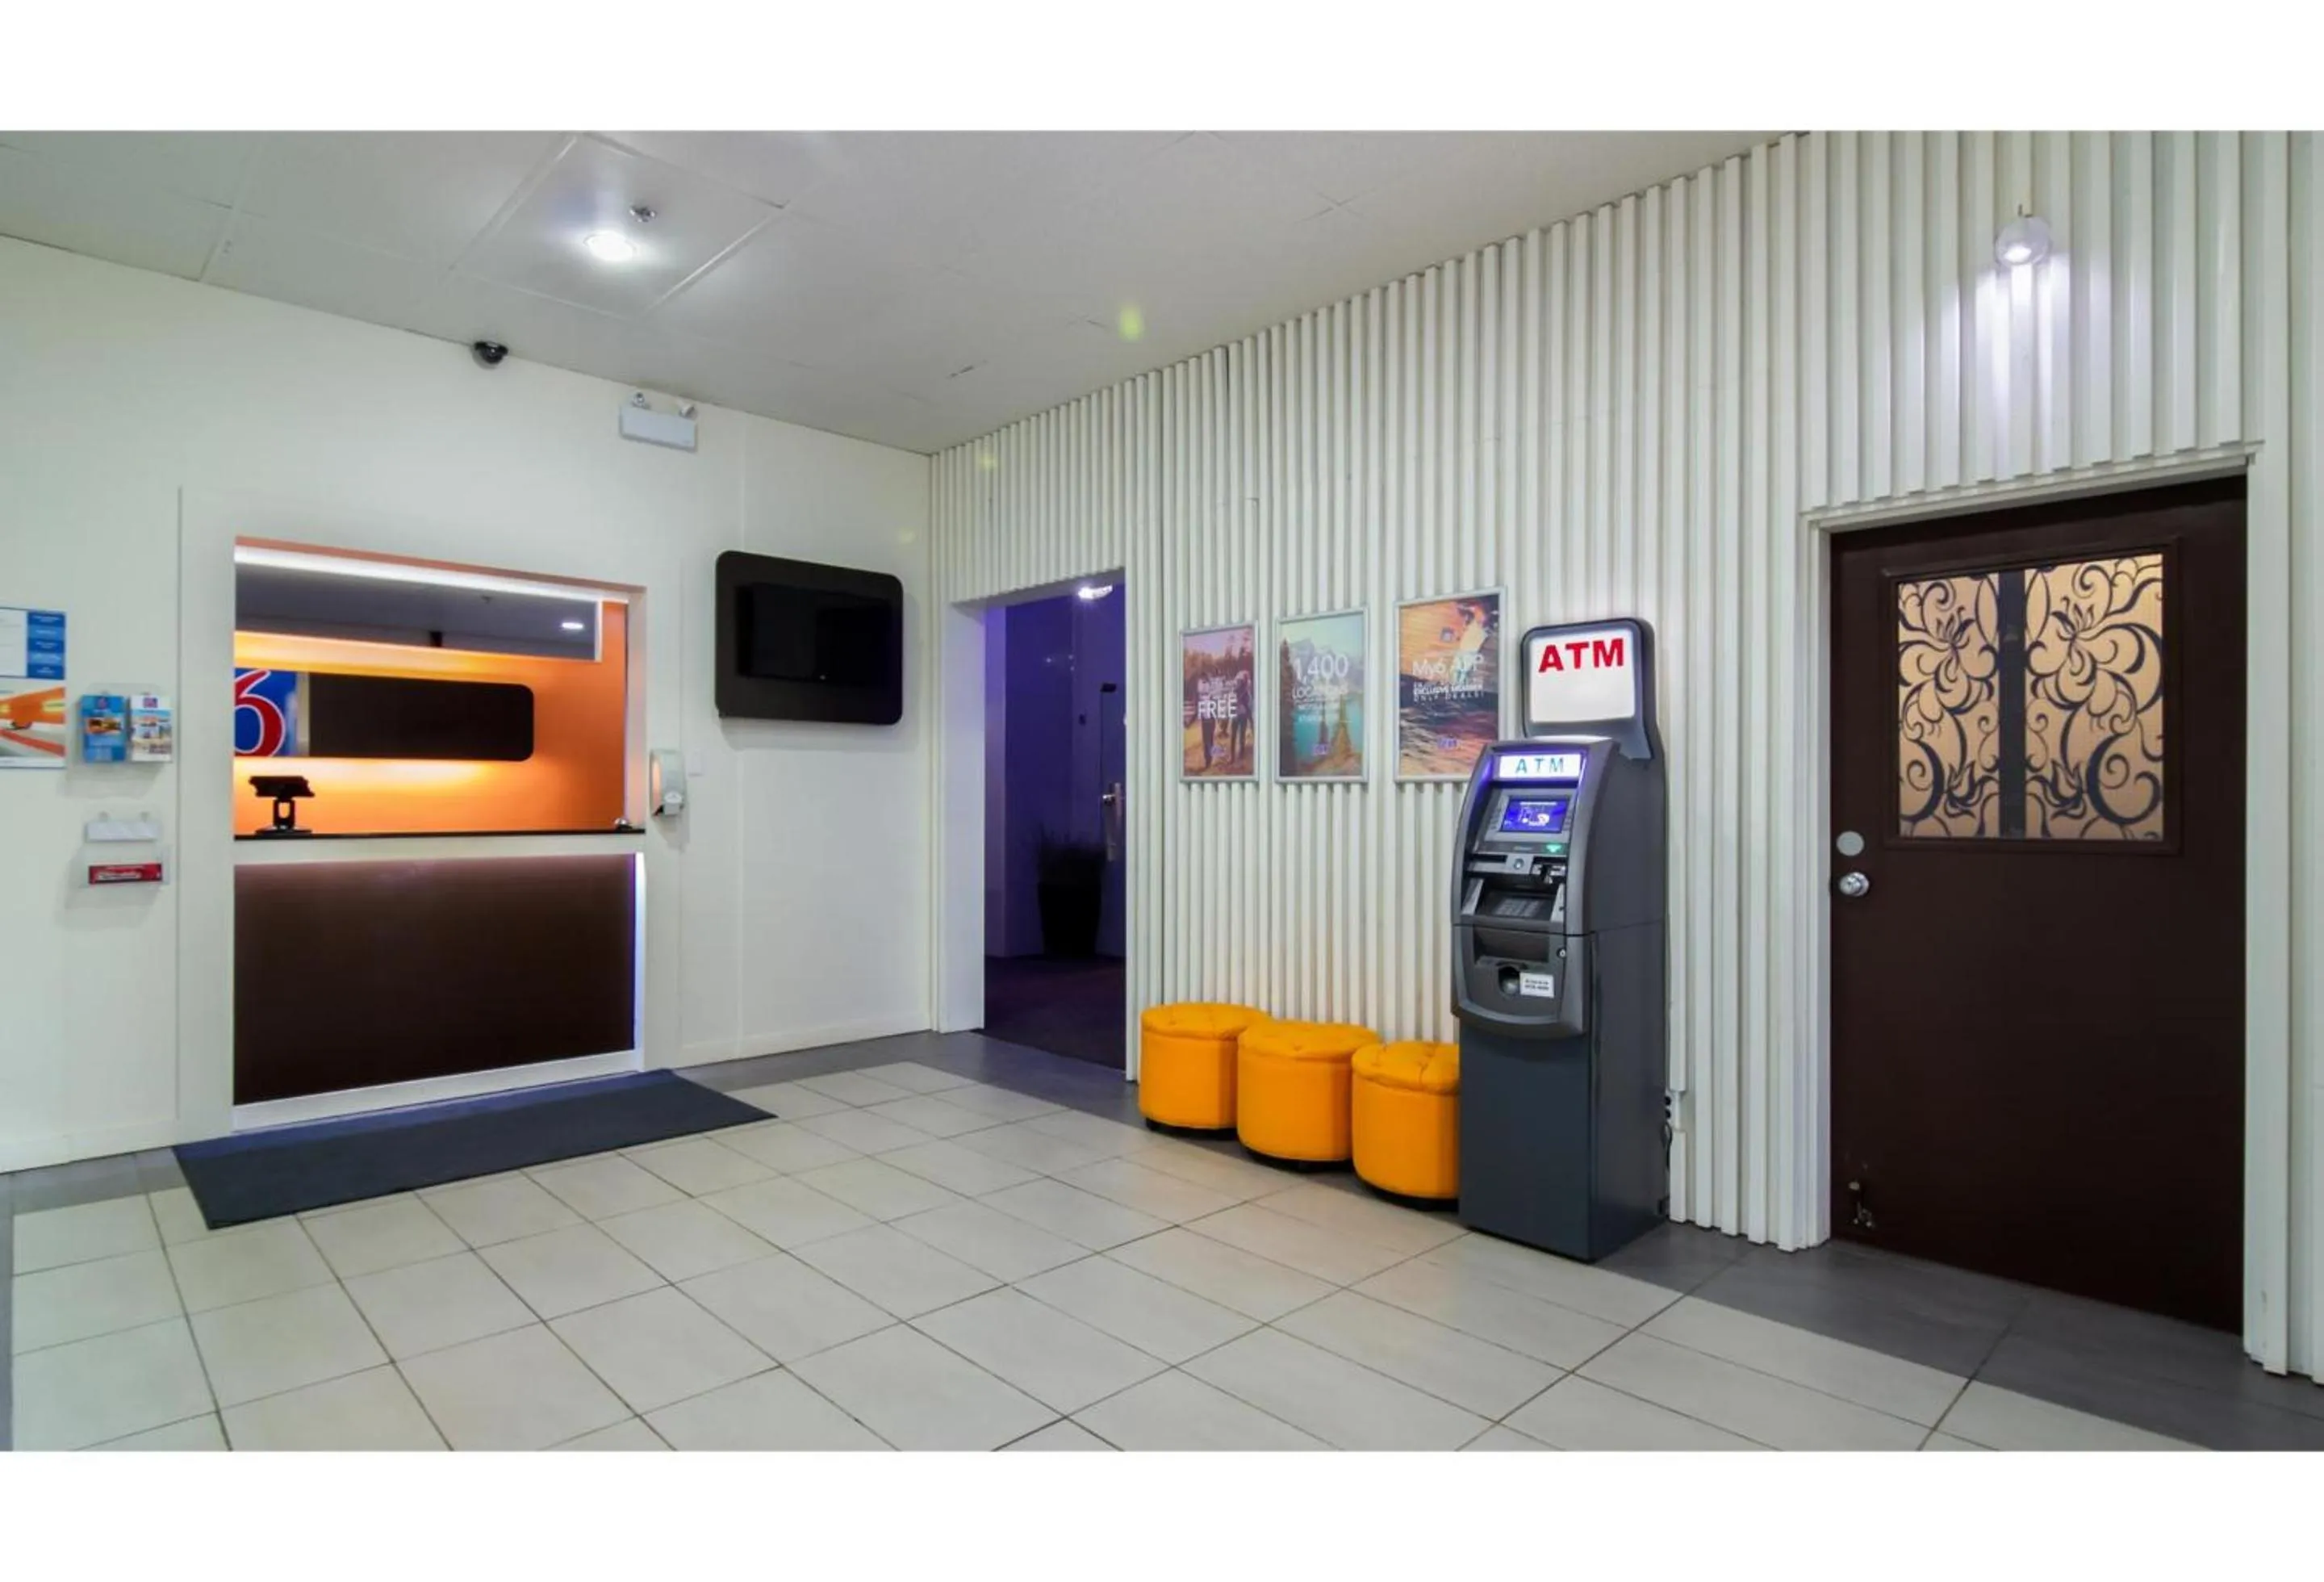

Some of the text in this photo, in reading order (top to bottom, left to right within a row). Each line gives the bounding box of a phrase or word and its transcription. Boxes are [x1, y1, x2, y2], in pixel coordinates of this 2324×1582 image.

[1293, 655, 1349, 685] 1,400
[1538, 638, 1624, 673] ATM
[235, 668, 286, 757] 6
[1198, 698, 1238, 719] FREE
[1515, 757, 1564, 773] ATM
